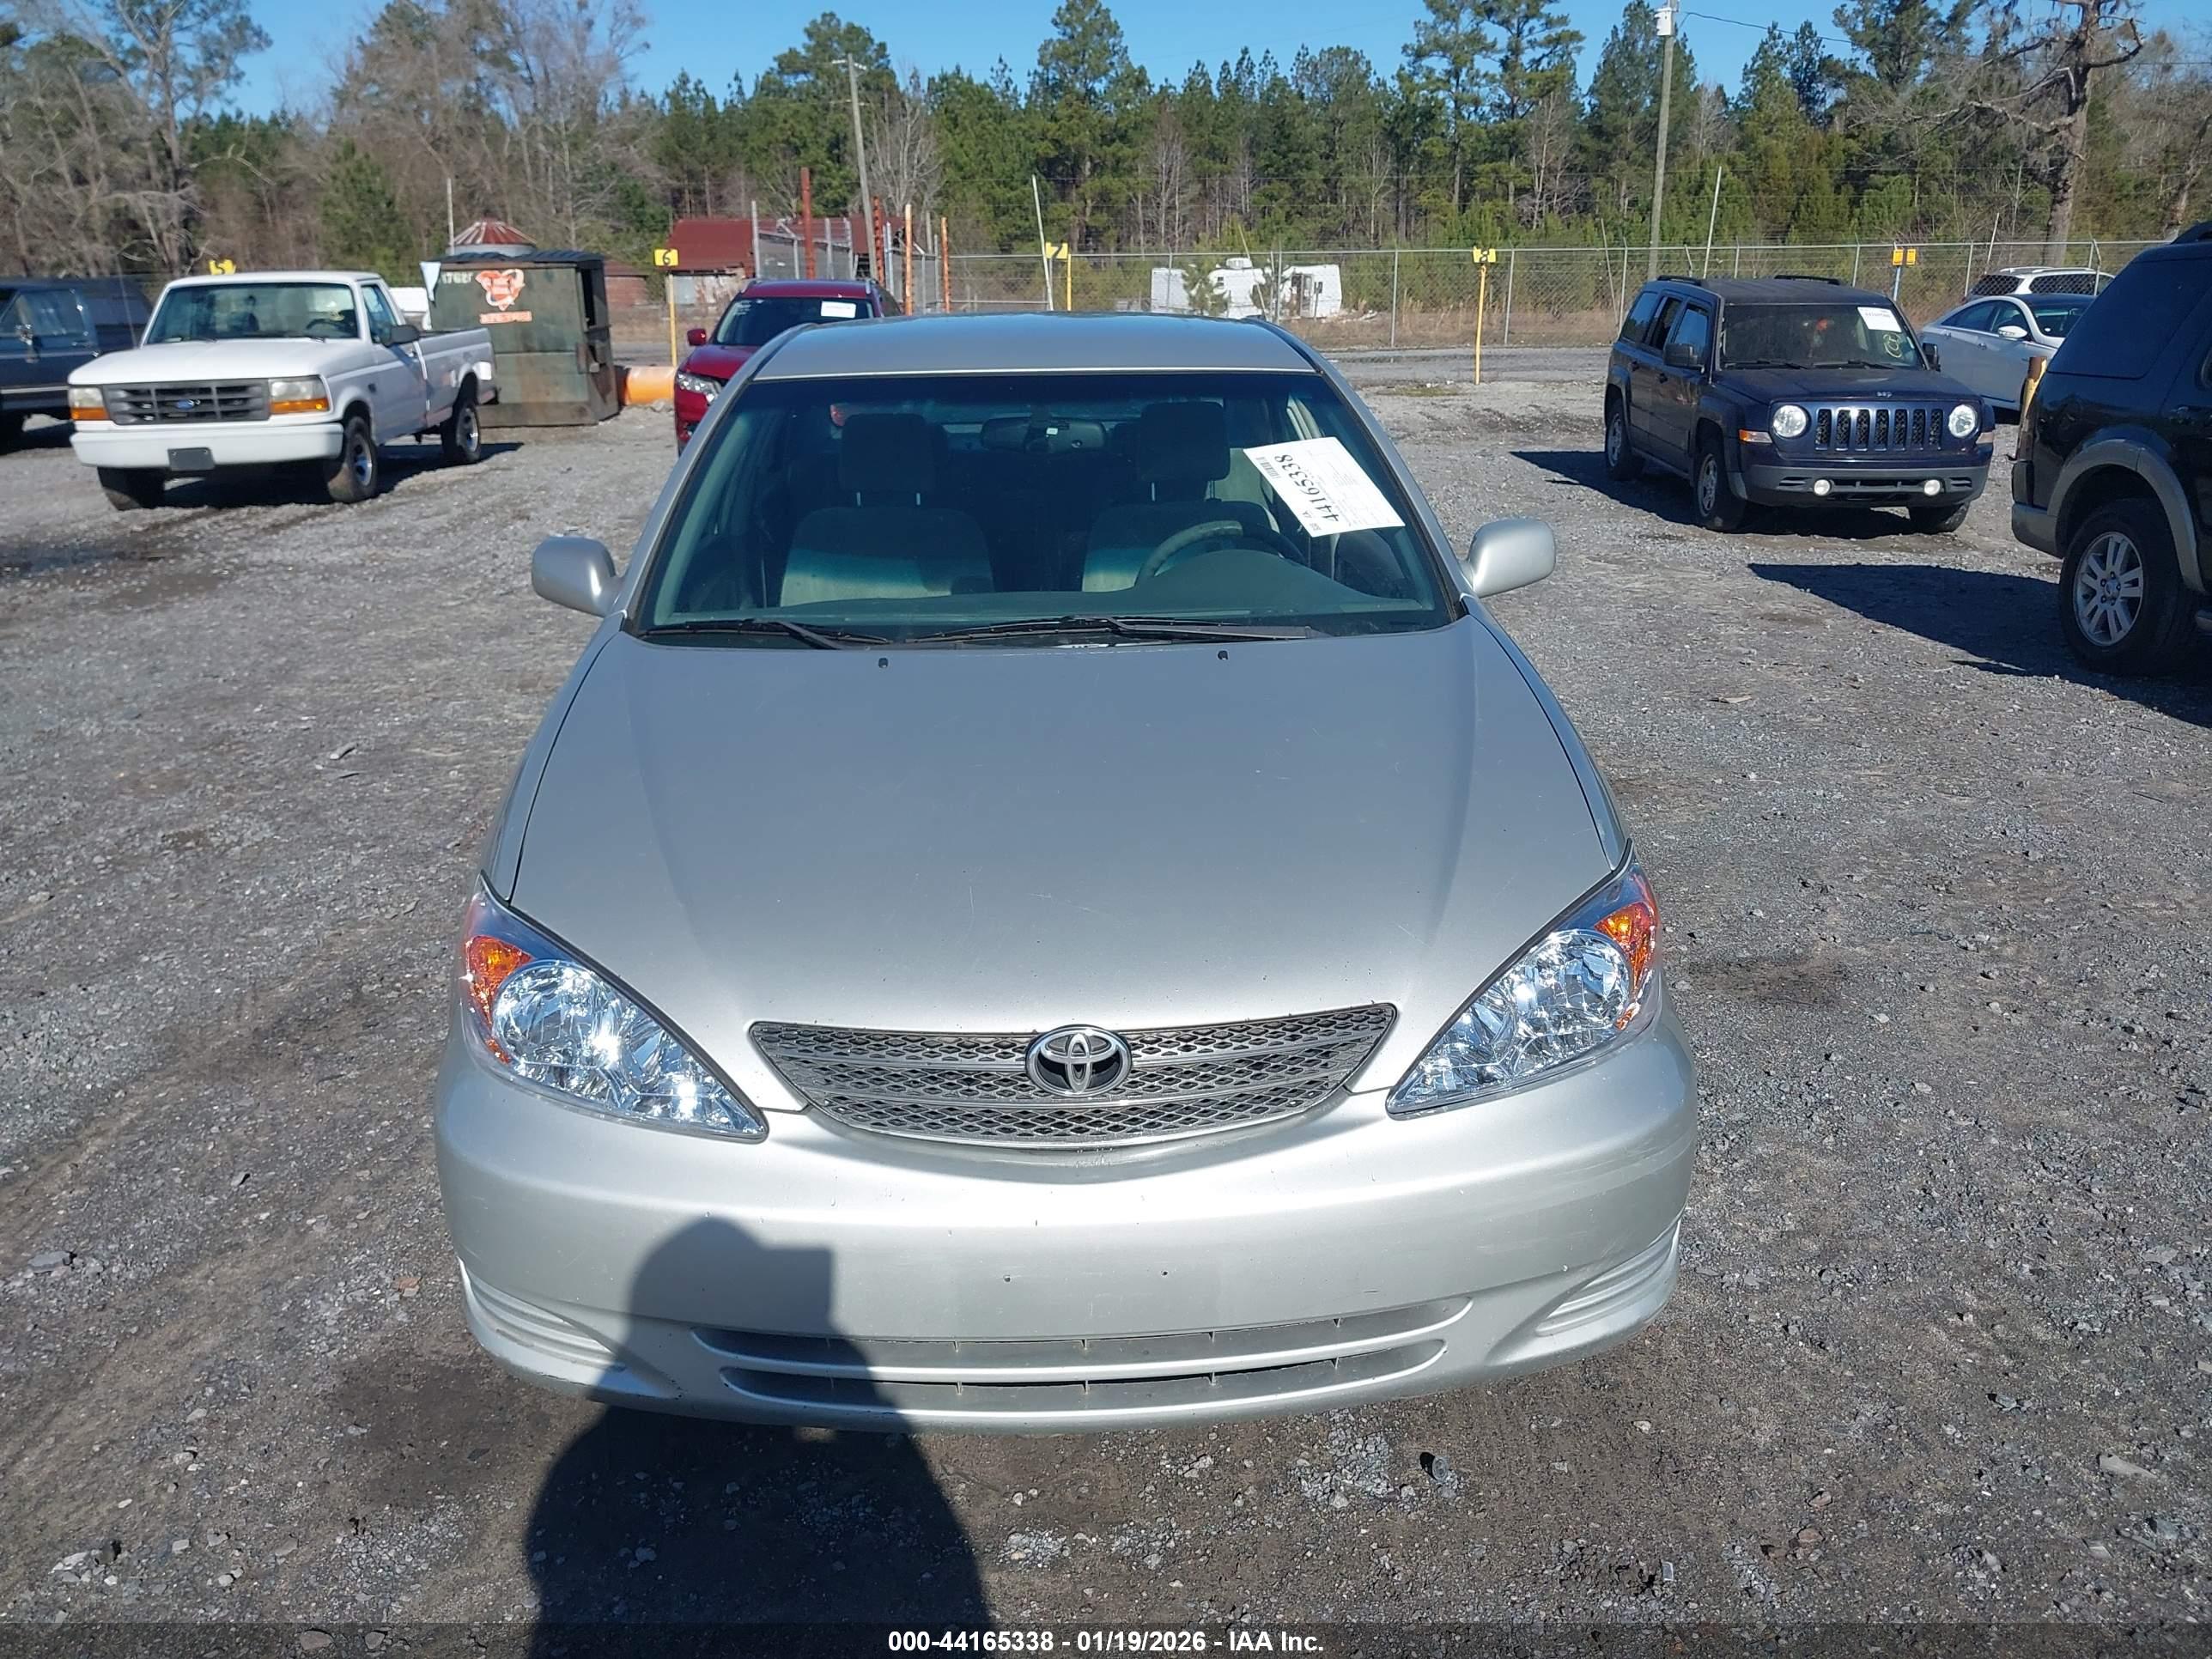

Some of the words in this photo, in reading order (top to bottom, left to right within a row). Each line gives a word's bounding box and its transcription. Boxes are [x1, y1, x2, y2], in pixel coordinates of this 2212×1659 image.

[662, 249, 672, 265] 6
[1050, 241, 1063, 259] 7
[1480, 247, 1490, 263] 8
[213, 258, 225, 275] 5
[1274, 454, 1340, 522] 44165338
